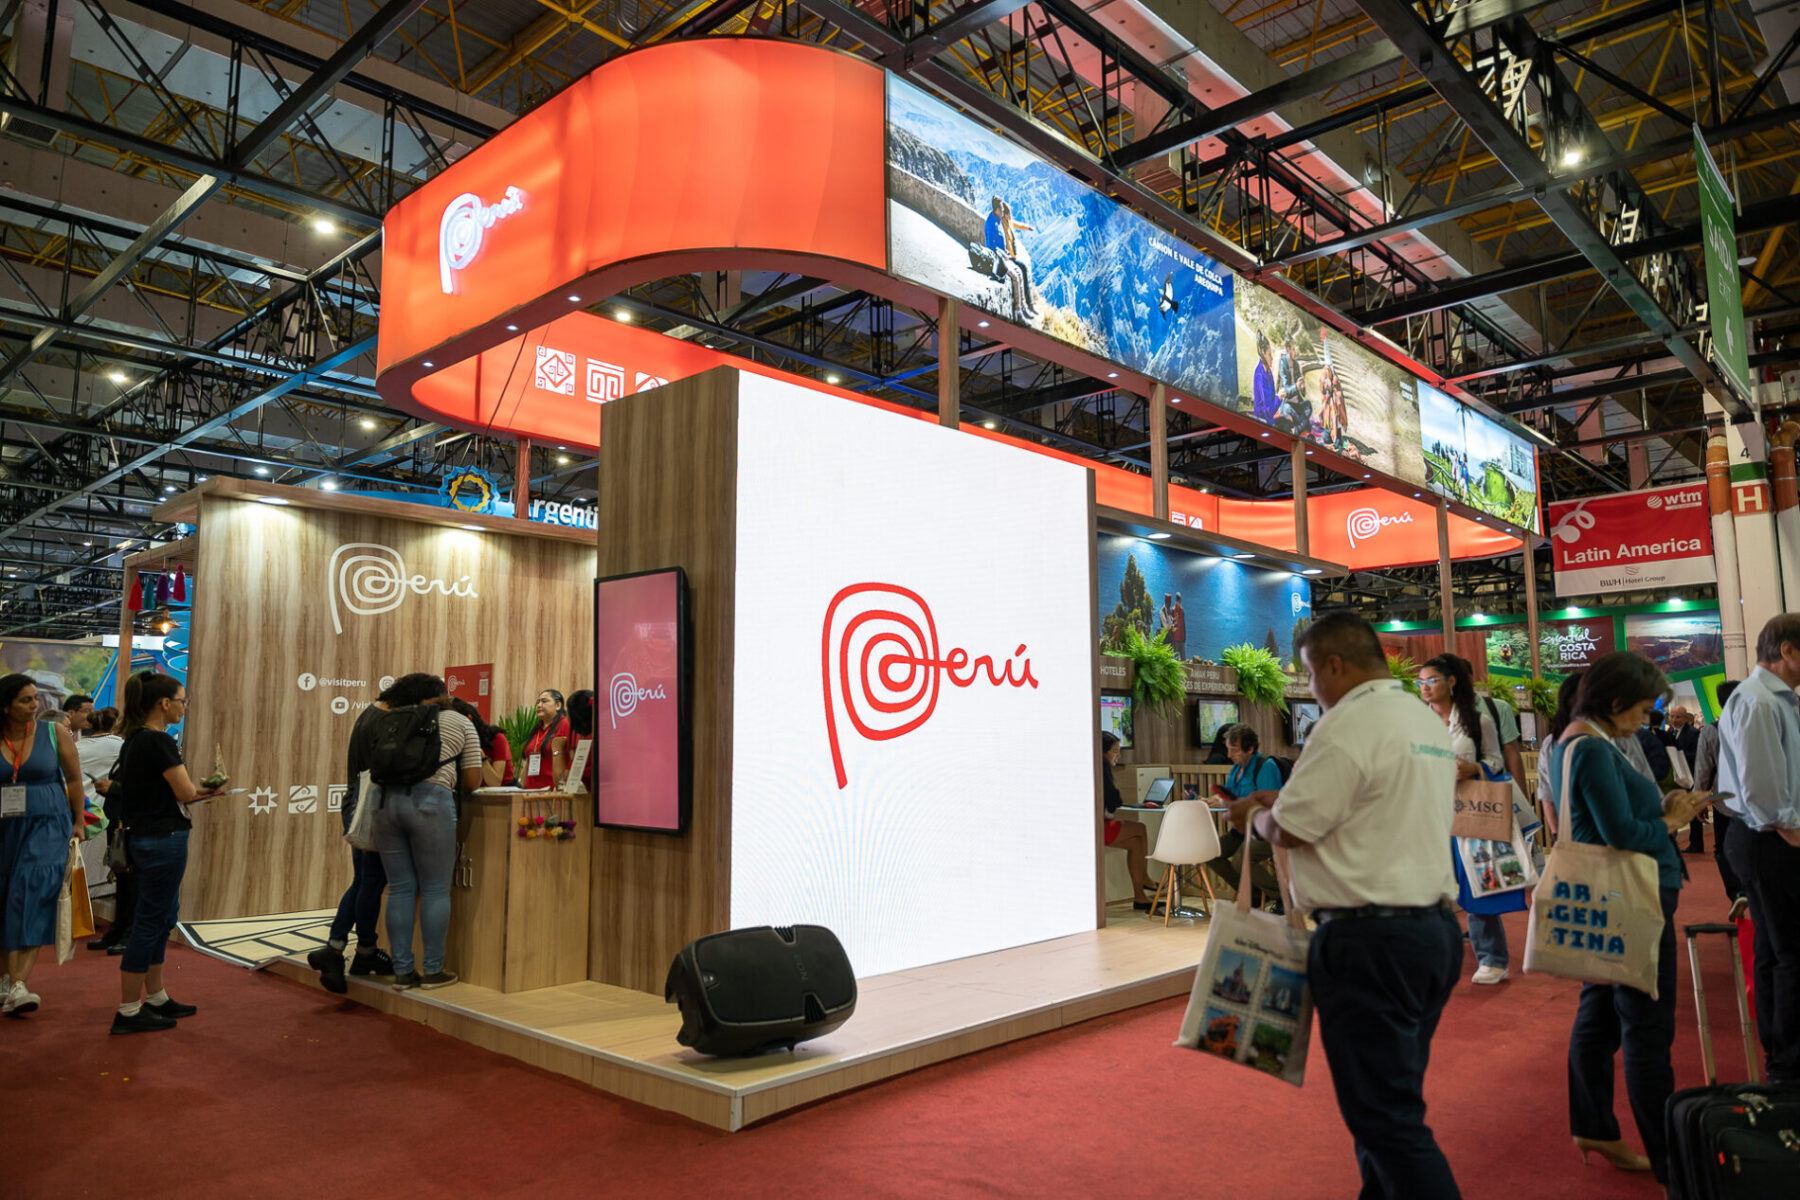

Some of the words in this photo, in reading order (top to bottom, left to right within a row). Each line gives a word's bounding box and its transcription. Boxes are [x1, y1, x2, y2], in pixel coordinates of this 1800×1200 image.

[1179, 253, 1196, 270] VALE
[1195, 263, 1205, 275] DE
[1204, 268, 1223, 286] COLCA
[1740, 447, 1751, 459] 4
[1664, 491, 1702, 505] wtm
[1736, 486, 1763, 513] H
[526, 499, 598, 529] rgenti
[1347, 507, 1414, 549] Perú
[1563, 547, 1611, 565] Latin
[1616, 538, 1701, 559] America
[328, 542, 479, 635] Perú
[1559, 642, 1596, 652] COSTA
[1560, 651, 1587, 661] RICA
[318, 677, 367, 687] @visitperu
[821, 577, 1039, 790] Perú
[1100, 665, 1127, 677] HOTELES
[609, 672, 666, 730] Perú
[1468, 800, 1504, 814] MSC
[1553, 881, 1591, 903] AR
[1553, 904, 1608, 929] GEN
[1551, 927, 1625, 956] TINA
